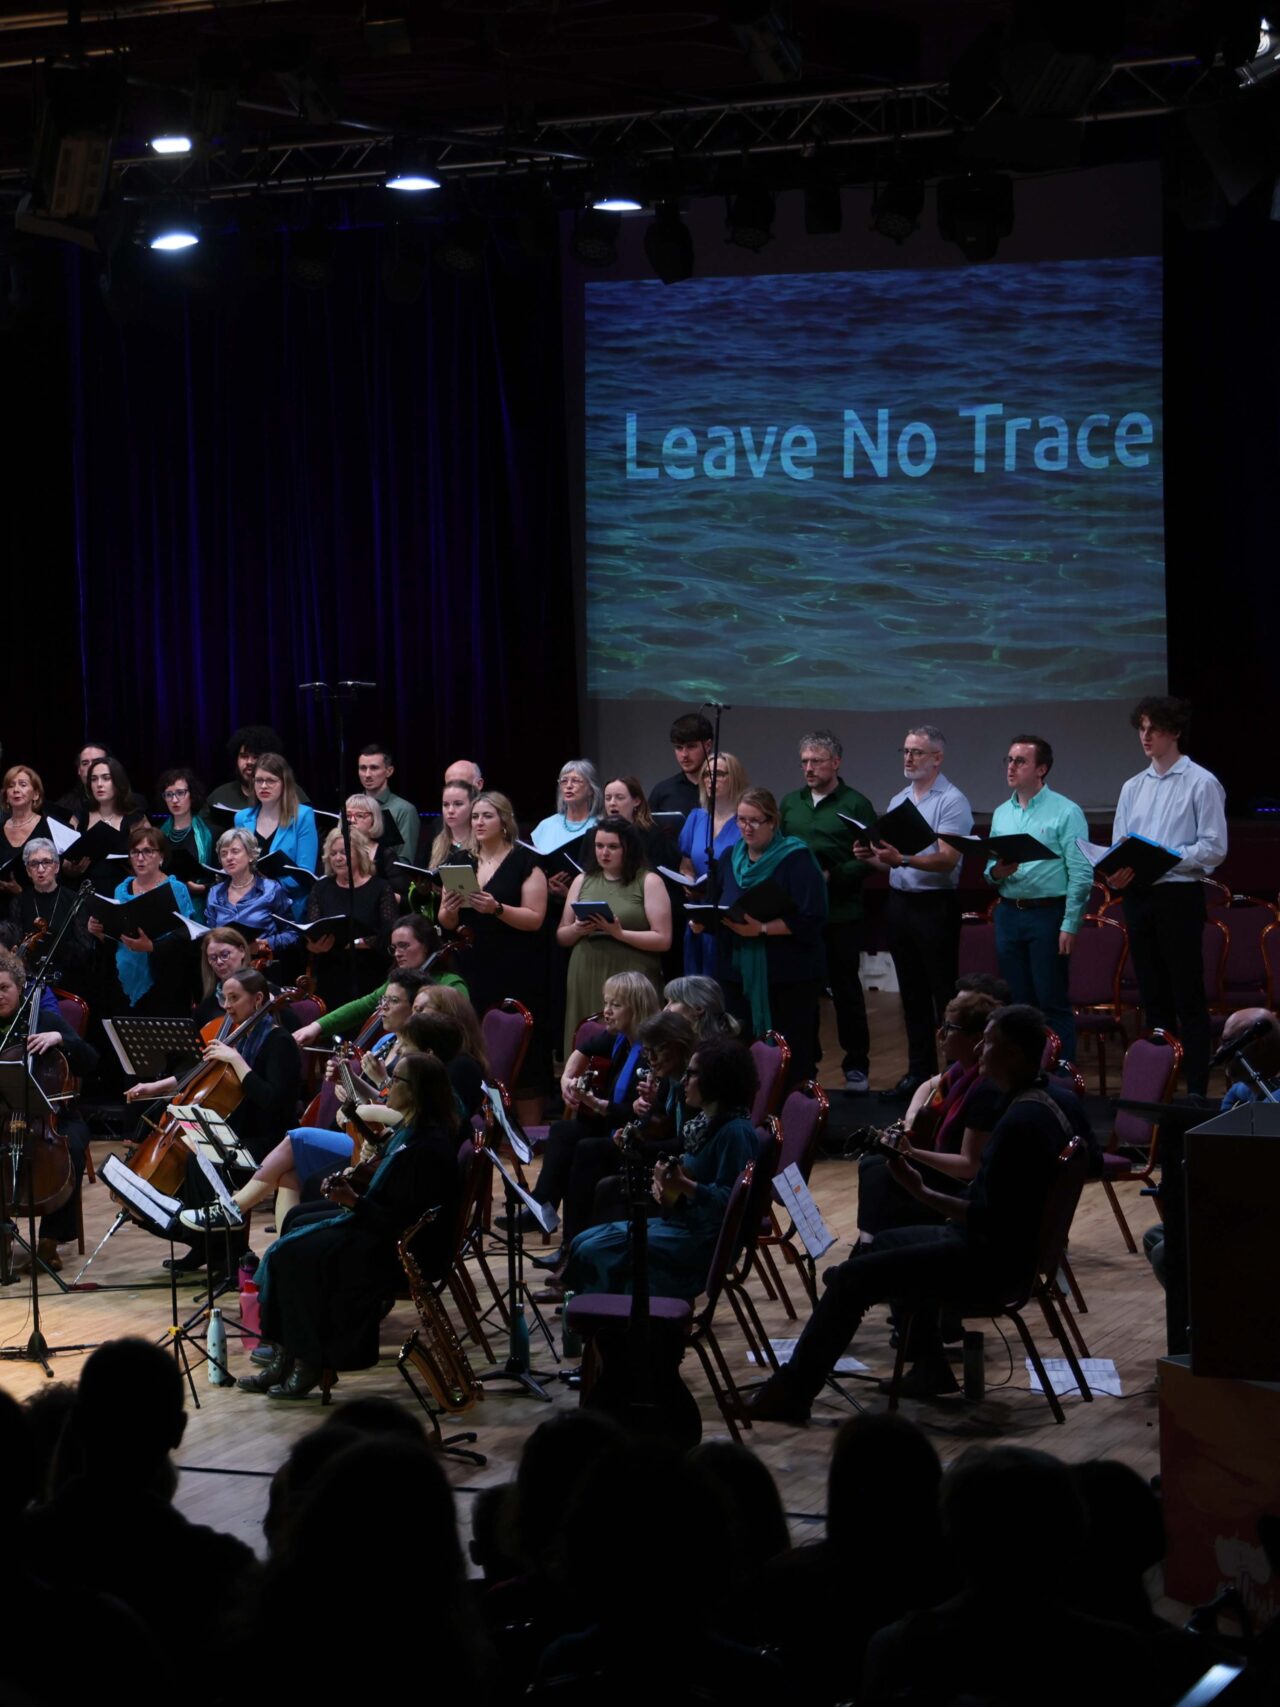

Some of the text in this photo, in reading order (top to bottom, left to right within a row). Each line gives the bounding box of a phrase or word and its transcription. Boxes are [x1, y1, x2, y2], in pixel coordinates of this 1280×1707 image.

[625, 403, 1154, 480] Leave No Trace
